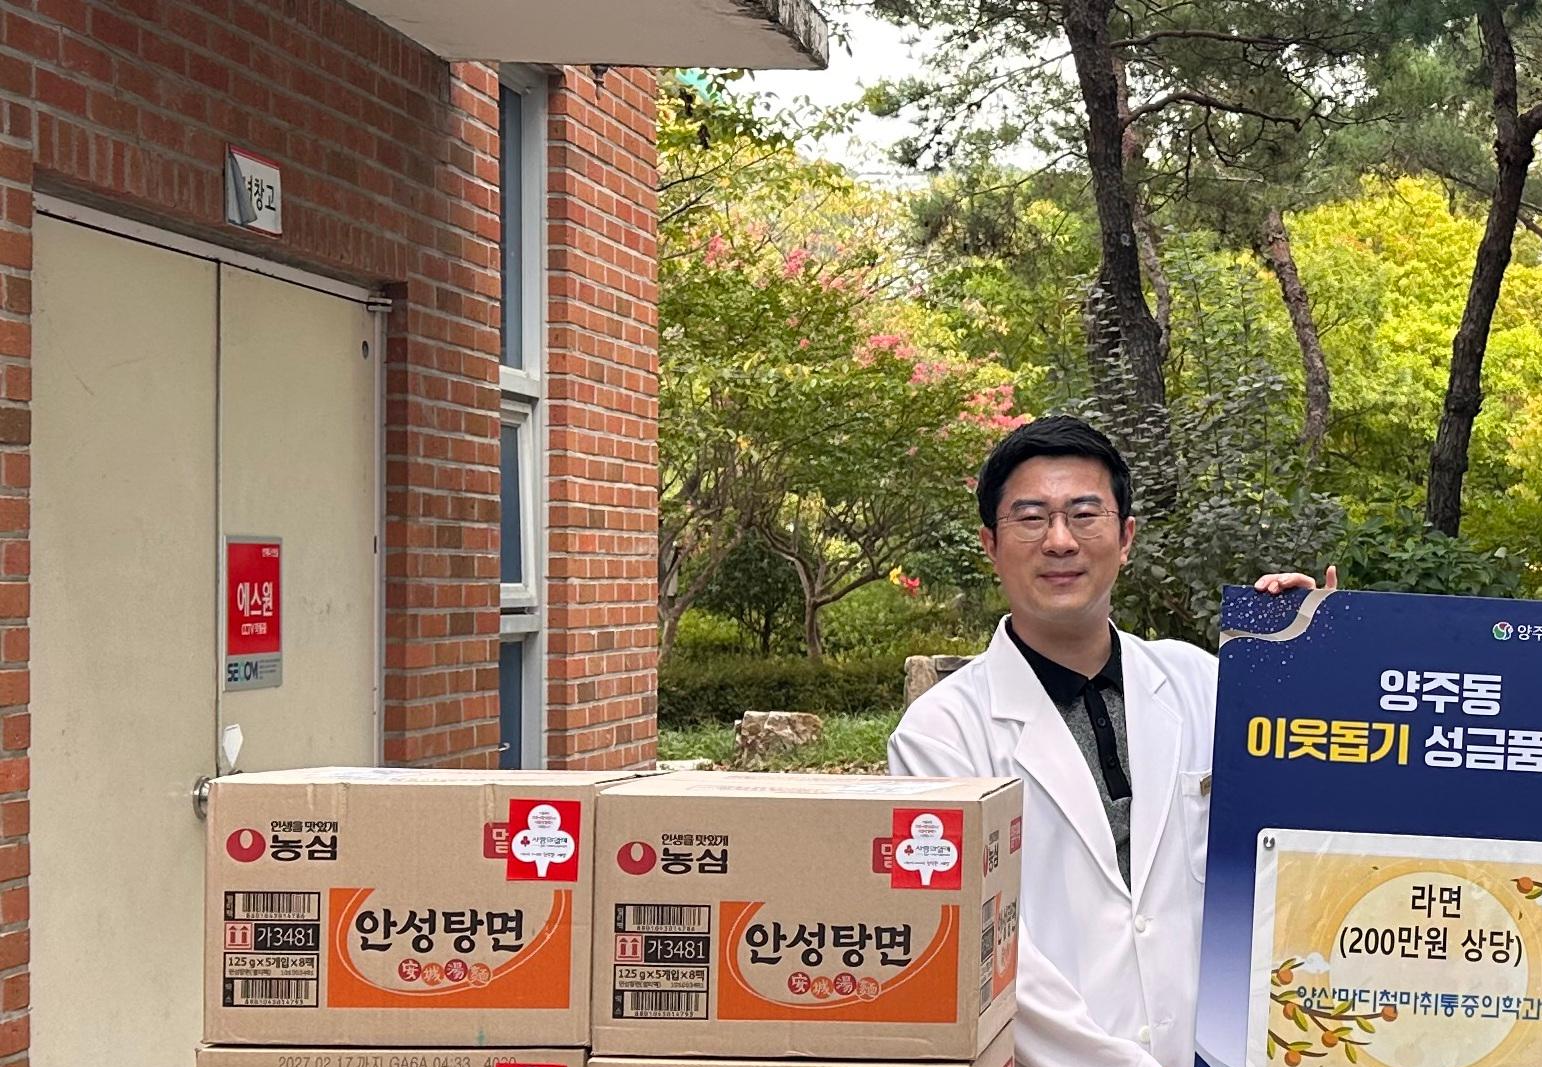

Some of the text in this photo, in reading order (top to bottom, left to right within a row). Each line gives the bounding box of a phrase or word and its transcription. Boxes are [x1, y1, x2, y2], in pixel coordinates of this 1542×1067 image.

[237, 581, 273, 617] 에스원
[227, 660, 258, 682] SECOM
[1380, 669, 1503, 716] 양주동
[1247, 716, 1409, 766] 이웃돕기
[270, 834, 338, 860] 농심
[661, 847, 728, 874] 농심
[1411, 883, 1462, 919] 라면
[257, 927, 316, 947] 가3481
[354, 908, 525, 952] 안성탕면
[744, 922, 913, 967] 안성탕면
[1339, 924, 1523, 967] (200만원 상당)
[647, 939, 706, 960] 가3481
